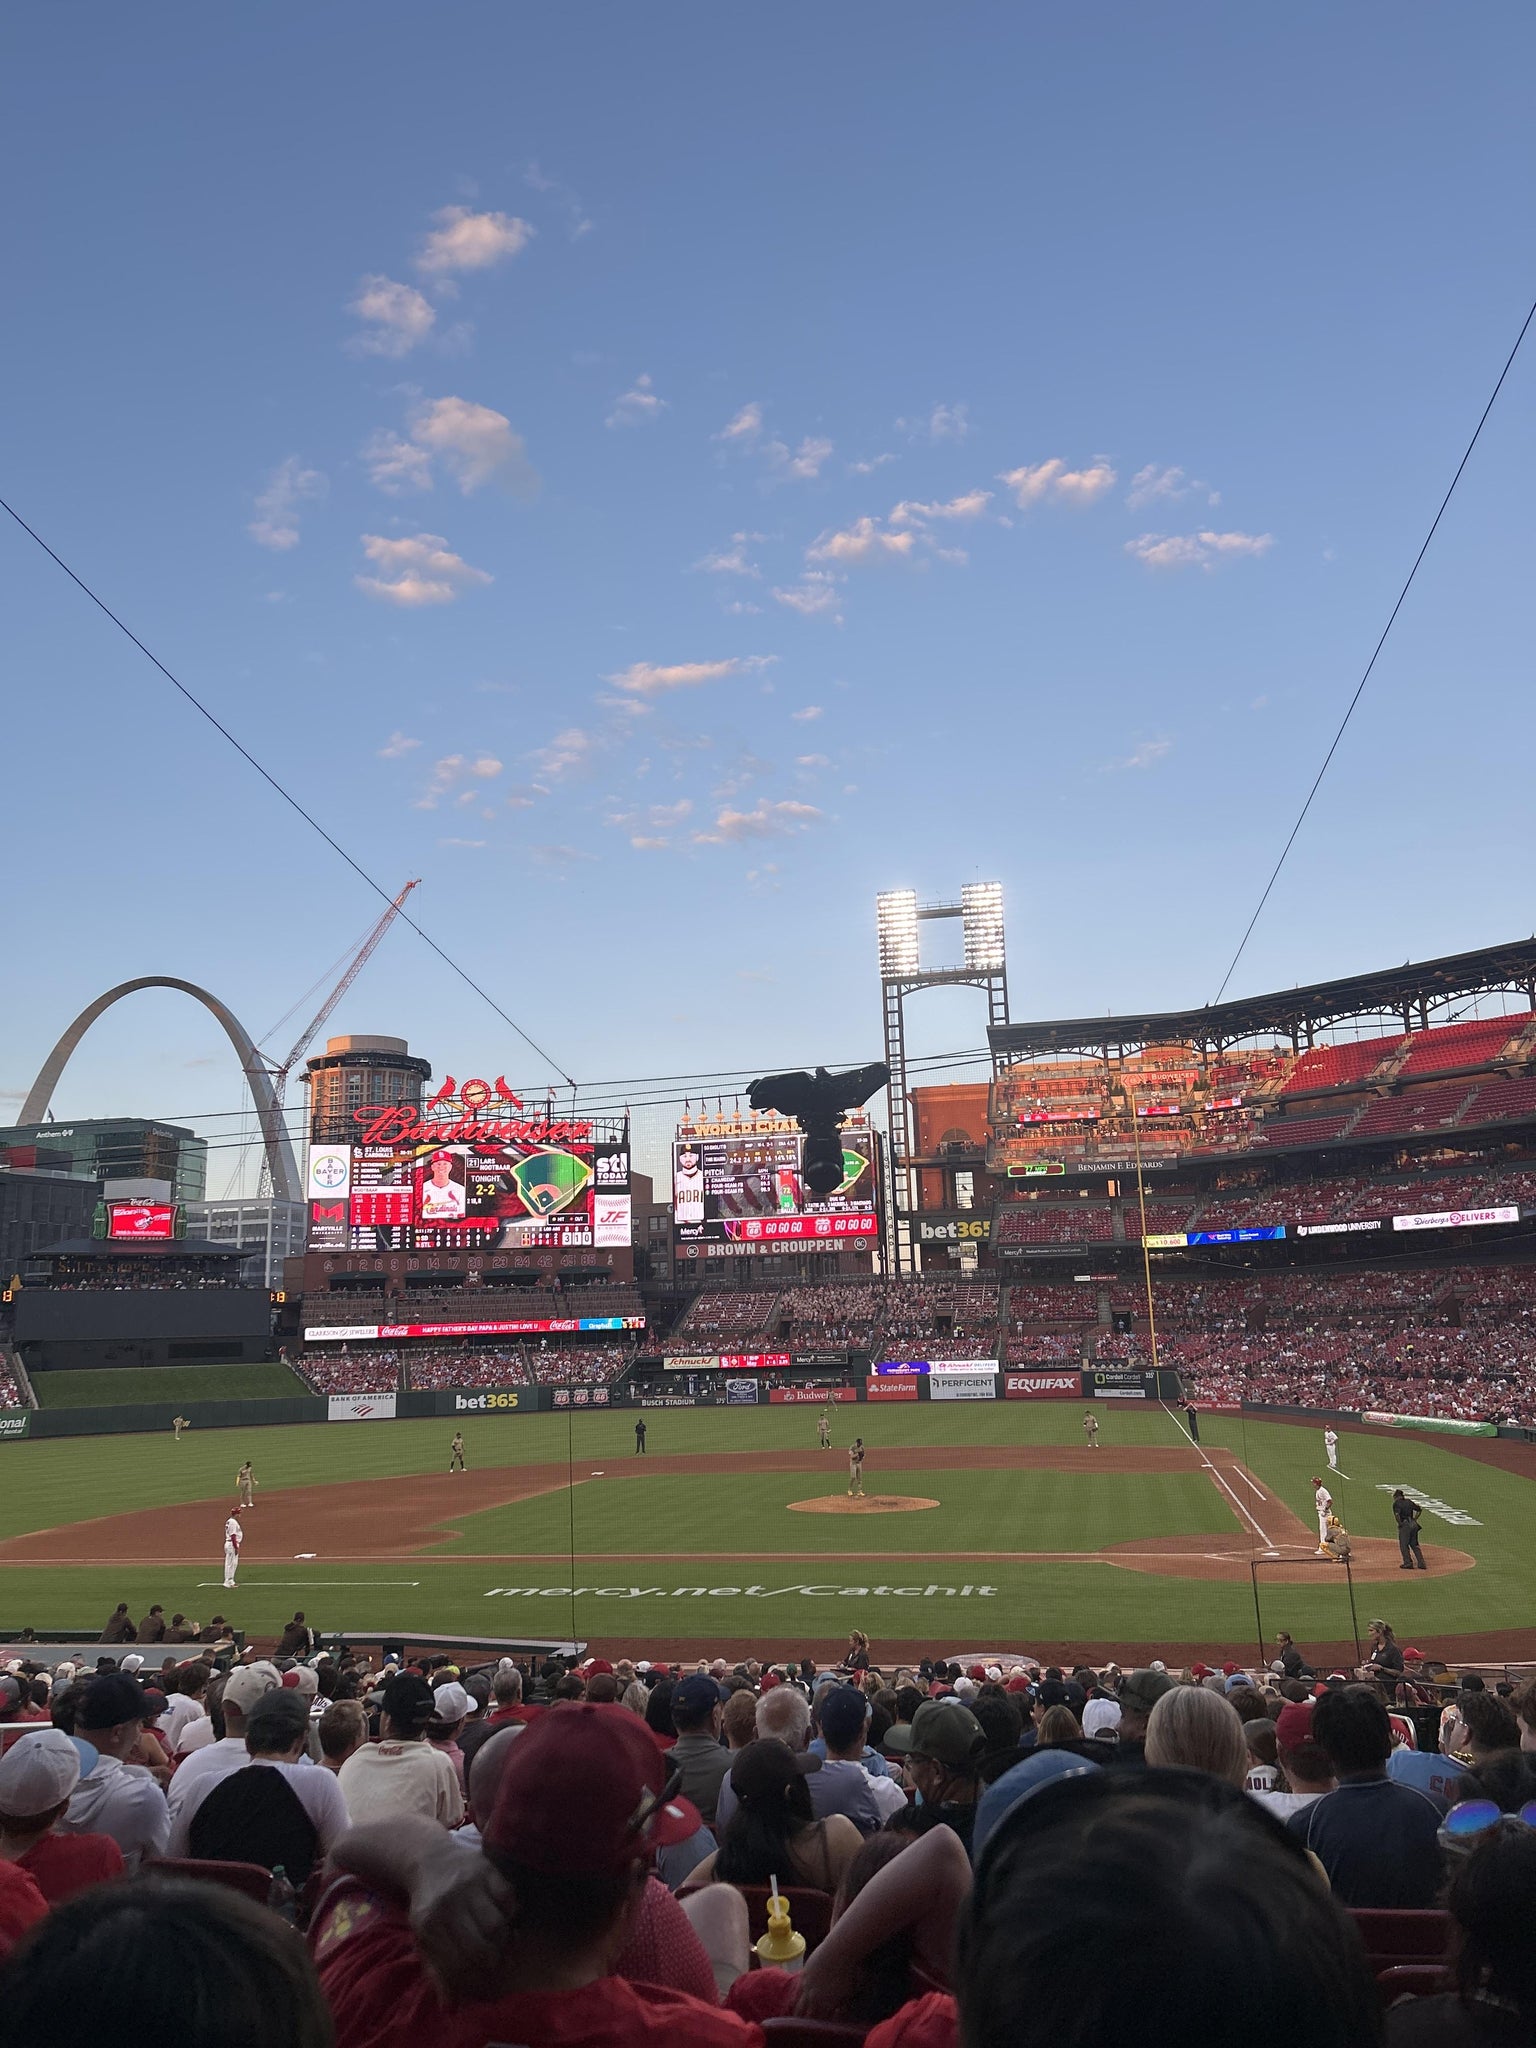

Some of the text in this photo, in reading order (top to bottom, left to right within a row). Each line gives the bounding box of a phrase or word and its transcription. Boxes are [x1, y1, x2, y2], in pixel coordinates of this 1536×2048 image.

[1151, 1072, 1195, 1080] BUDWEISER
[353, 1106, 593, 1144] Budweiser
[694, 1122, 752, 1137] WORLD
[36, 1130, 62, 1139] Anthem
[596, 1153, 628, 1172] stl
[1078, 1163, 1116, 1171] BENJAMIN
[476, 1184, 496, 1195] 2-2
[835, 1220, 846, 1230] GO
[847, 1219, 859, 1230] GO
[861, 1218, 873, 1229] GO
[1414, 1215, 1449, 1226] Dierbergs
[681, 1227, 699, 1236] Mercy
[765, 1223, 777, 1233] GO
[778, 1222, 790, 1233] GO
[791, 1222, 802, 1232] GO
[1308, 1221, 1382, 1234] LINDENWOOD UNIVERSITY
[707, 1242, 756, 1256] BROWN
[760, 1245, 768, 1253] &
[772, 1239, 843, 1253] CROUPPEN
[359, 1260, 368, 1271] 2
[374, 1259, 383, 1271] 6
[390, 1259, 399, 1271] 9
[407, 1258, 419, 1270] 10
[427, 1258, 440, 1270] 14
[448, 1257, 460, 1269] 17
[467, 1257, 483, 1269] 20
[492, 1256, 508, 1268] 23
[515, 1255, 530, 1267] 24
[537, 1255, 553, 1267] 42
[350, 1328, 375, 1336] JEWELERS
[381, 1325, 409, 1337] Coca-Cola
[549, 1320, 575, 1330] Coca-Cola
[668, 1357, 715, 1366] Schnucks
[732, 1381, 751, 1391] Ford
[941, 1378, 993, 1387] PERFICIENT
[1007, 1377, 1076, 1393] EQUIFAX
[797, 1390, 843, 1400] Budweier
[455, 1393, 518, 1410] bet365
[642, 1398, 696, 1407] BUSCH STADIUM
